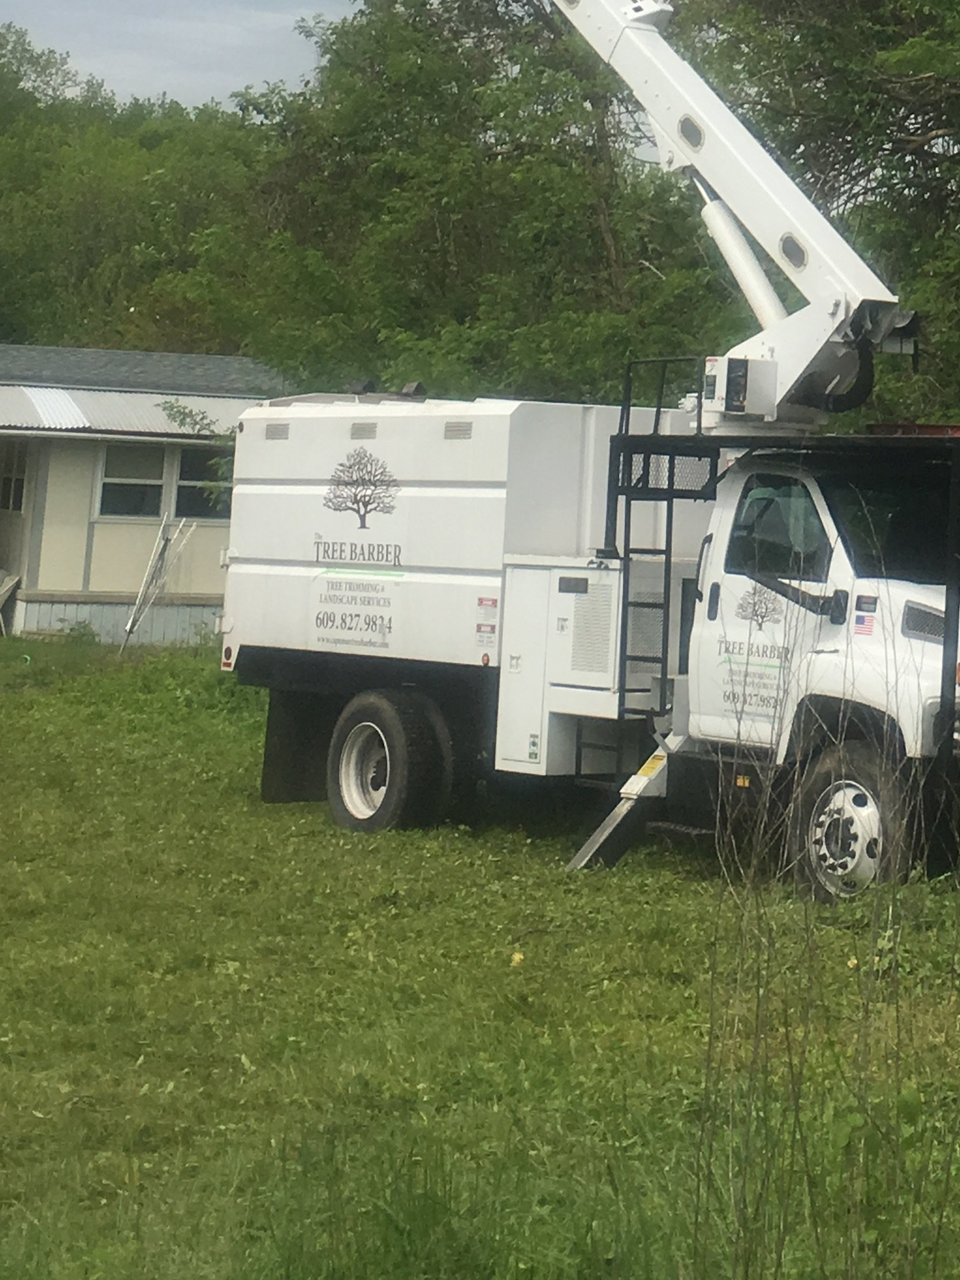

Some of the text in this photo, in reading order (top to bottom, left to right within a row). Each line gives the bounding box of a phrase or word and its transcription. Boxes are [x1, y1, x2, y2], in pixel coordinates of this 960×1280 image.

[313, 541, 403, 567] TREE BARBER
[718, 640, 745, 657] TREE
